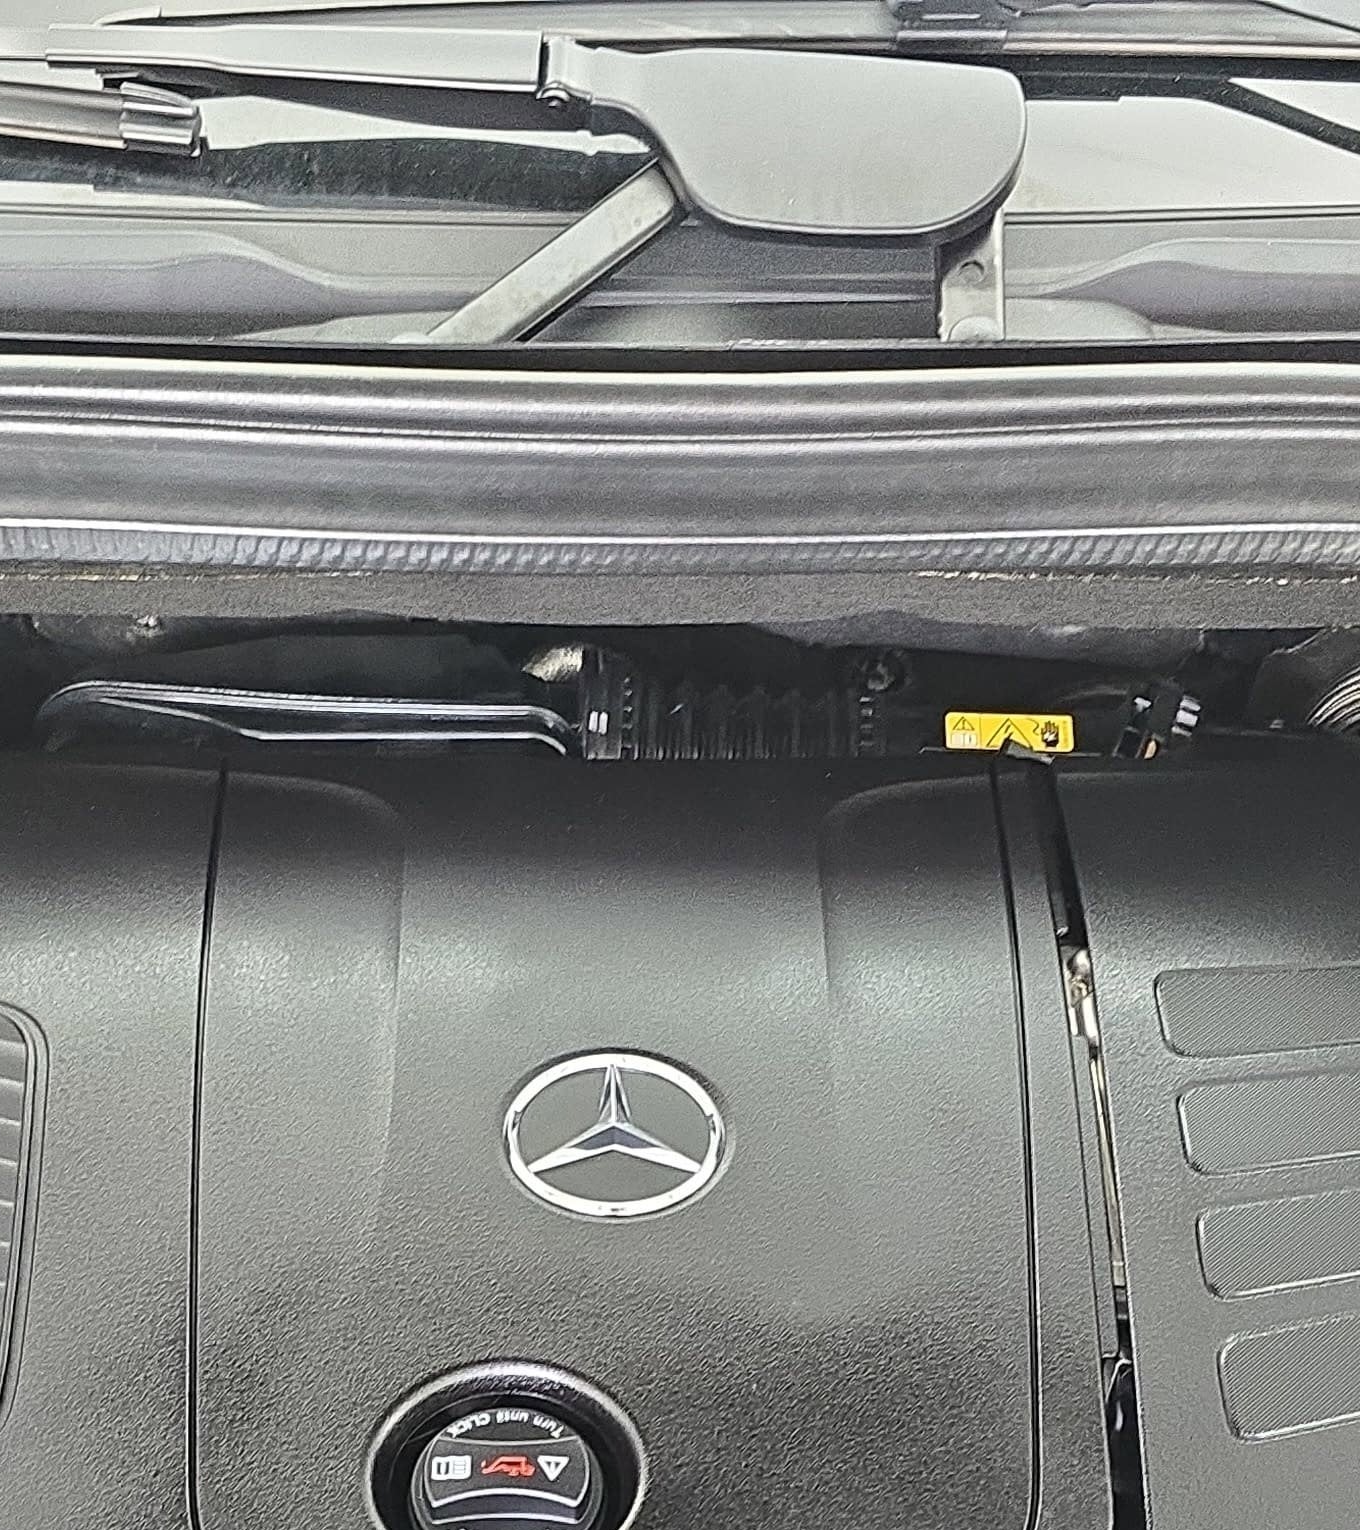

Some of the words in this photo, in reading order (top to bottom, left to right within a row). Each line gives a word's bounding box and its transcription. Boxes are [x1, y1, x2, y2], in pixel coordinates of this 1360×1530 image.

[447, 1414, 491, 1438] CLICK
[497, 1410, 529, 1425] until
[534, 1415, 565, 1438] Turn
